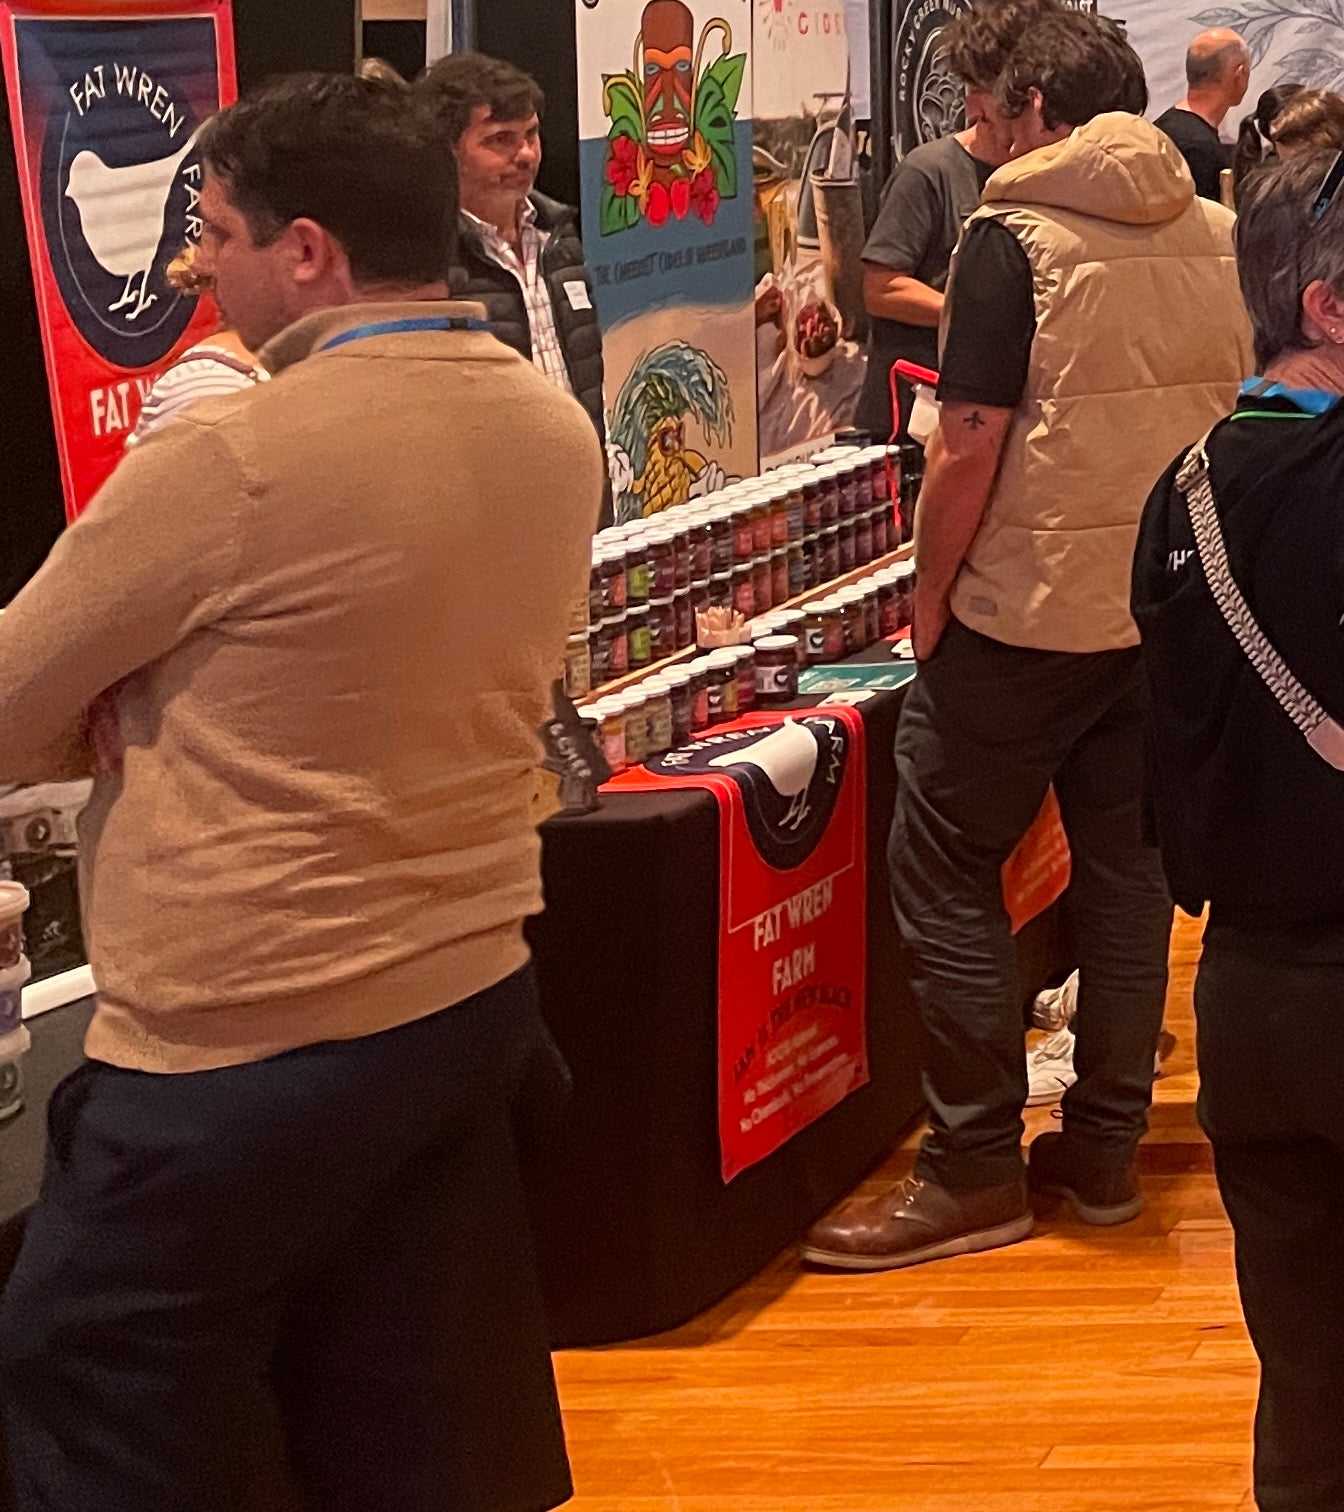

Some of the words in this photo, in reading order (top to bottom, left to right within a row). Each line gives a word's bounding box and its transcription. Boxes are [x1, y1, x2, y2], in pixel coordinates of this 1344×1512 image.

[70, 65, 105, 116] FAT
[113, 62, 187, 138] WREN
[182, 163, 204, 250] FAR
[90, 383, 131, 437] FAT
[754, 906, 783, 952] FAT
[786, 877, 834, 929] WREN
[772, 942, 816, 996] FARM
